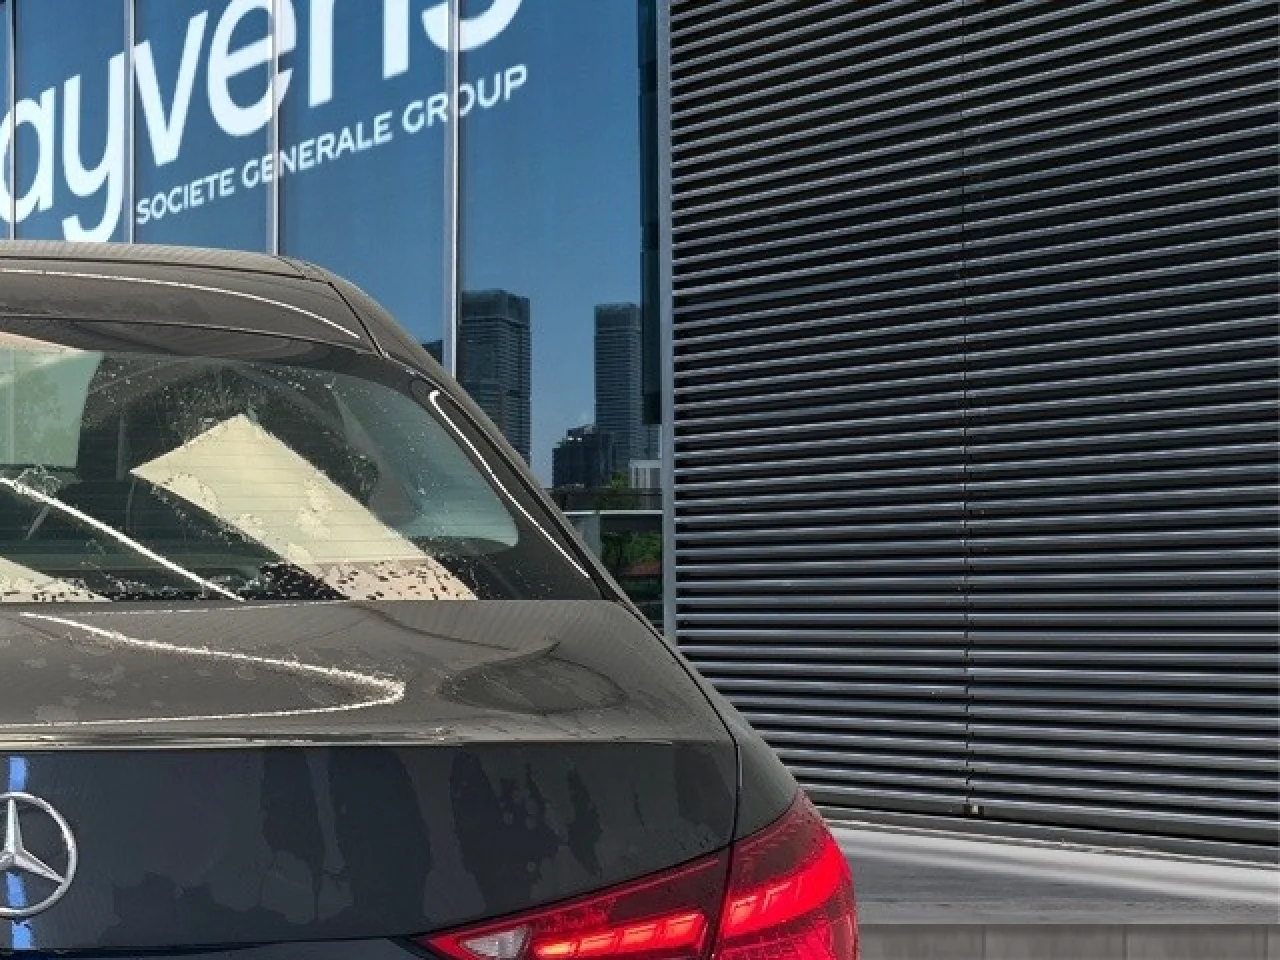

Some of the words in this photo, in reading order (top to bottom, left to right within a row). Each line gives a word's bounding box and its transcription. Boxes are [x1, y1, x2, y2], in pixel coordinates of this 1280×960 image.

[135, 167, 236, 225] SOCIETE
[241, 110, 394, 189] GENERALE
[401, 63, 528, 133] GROUP
